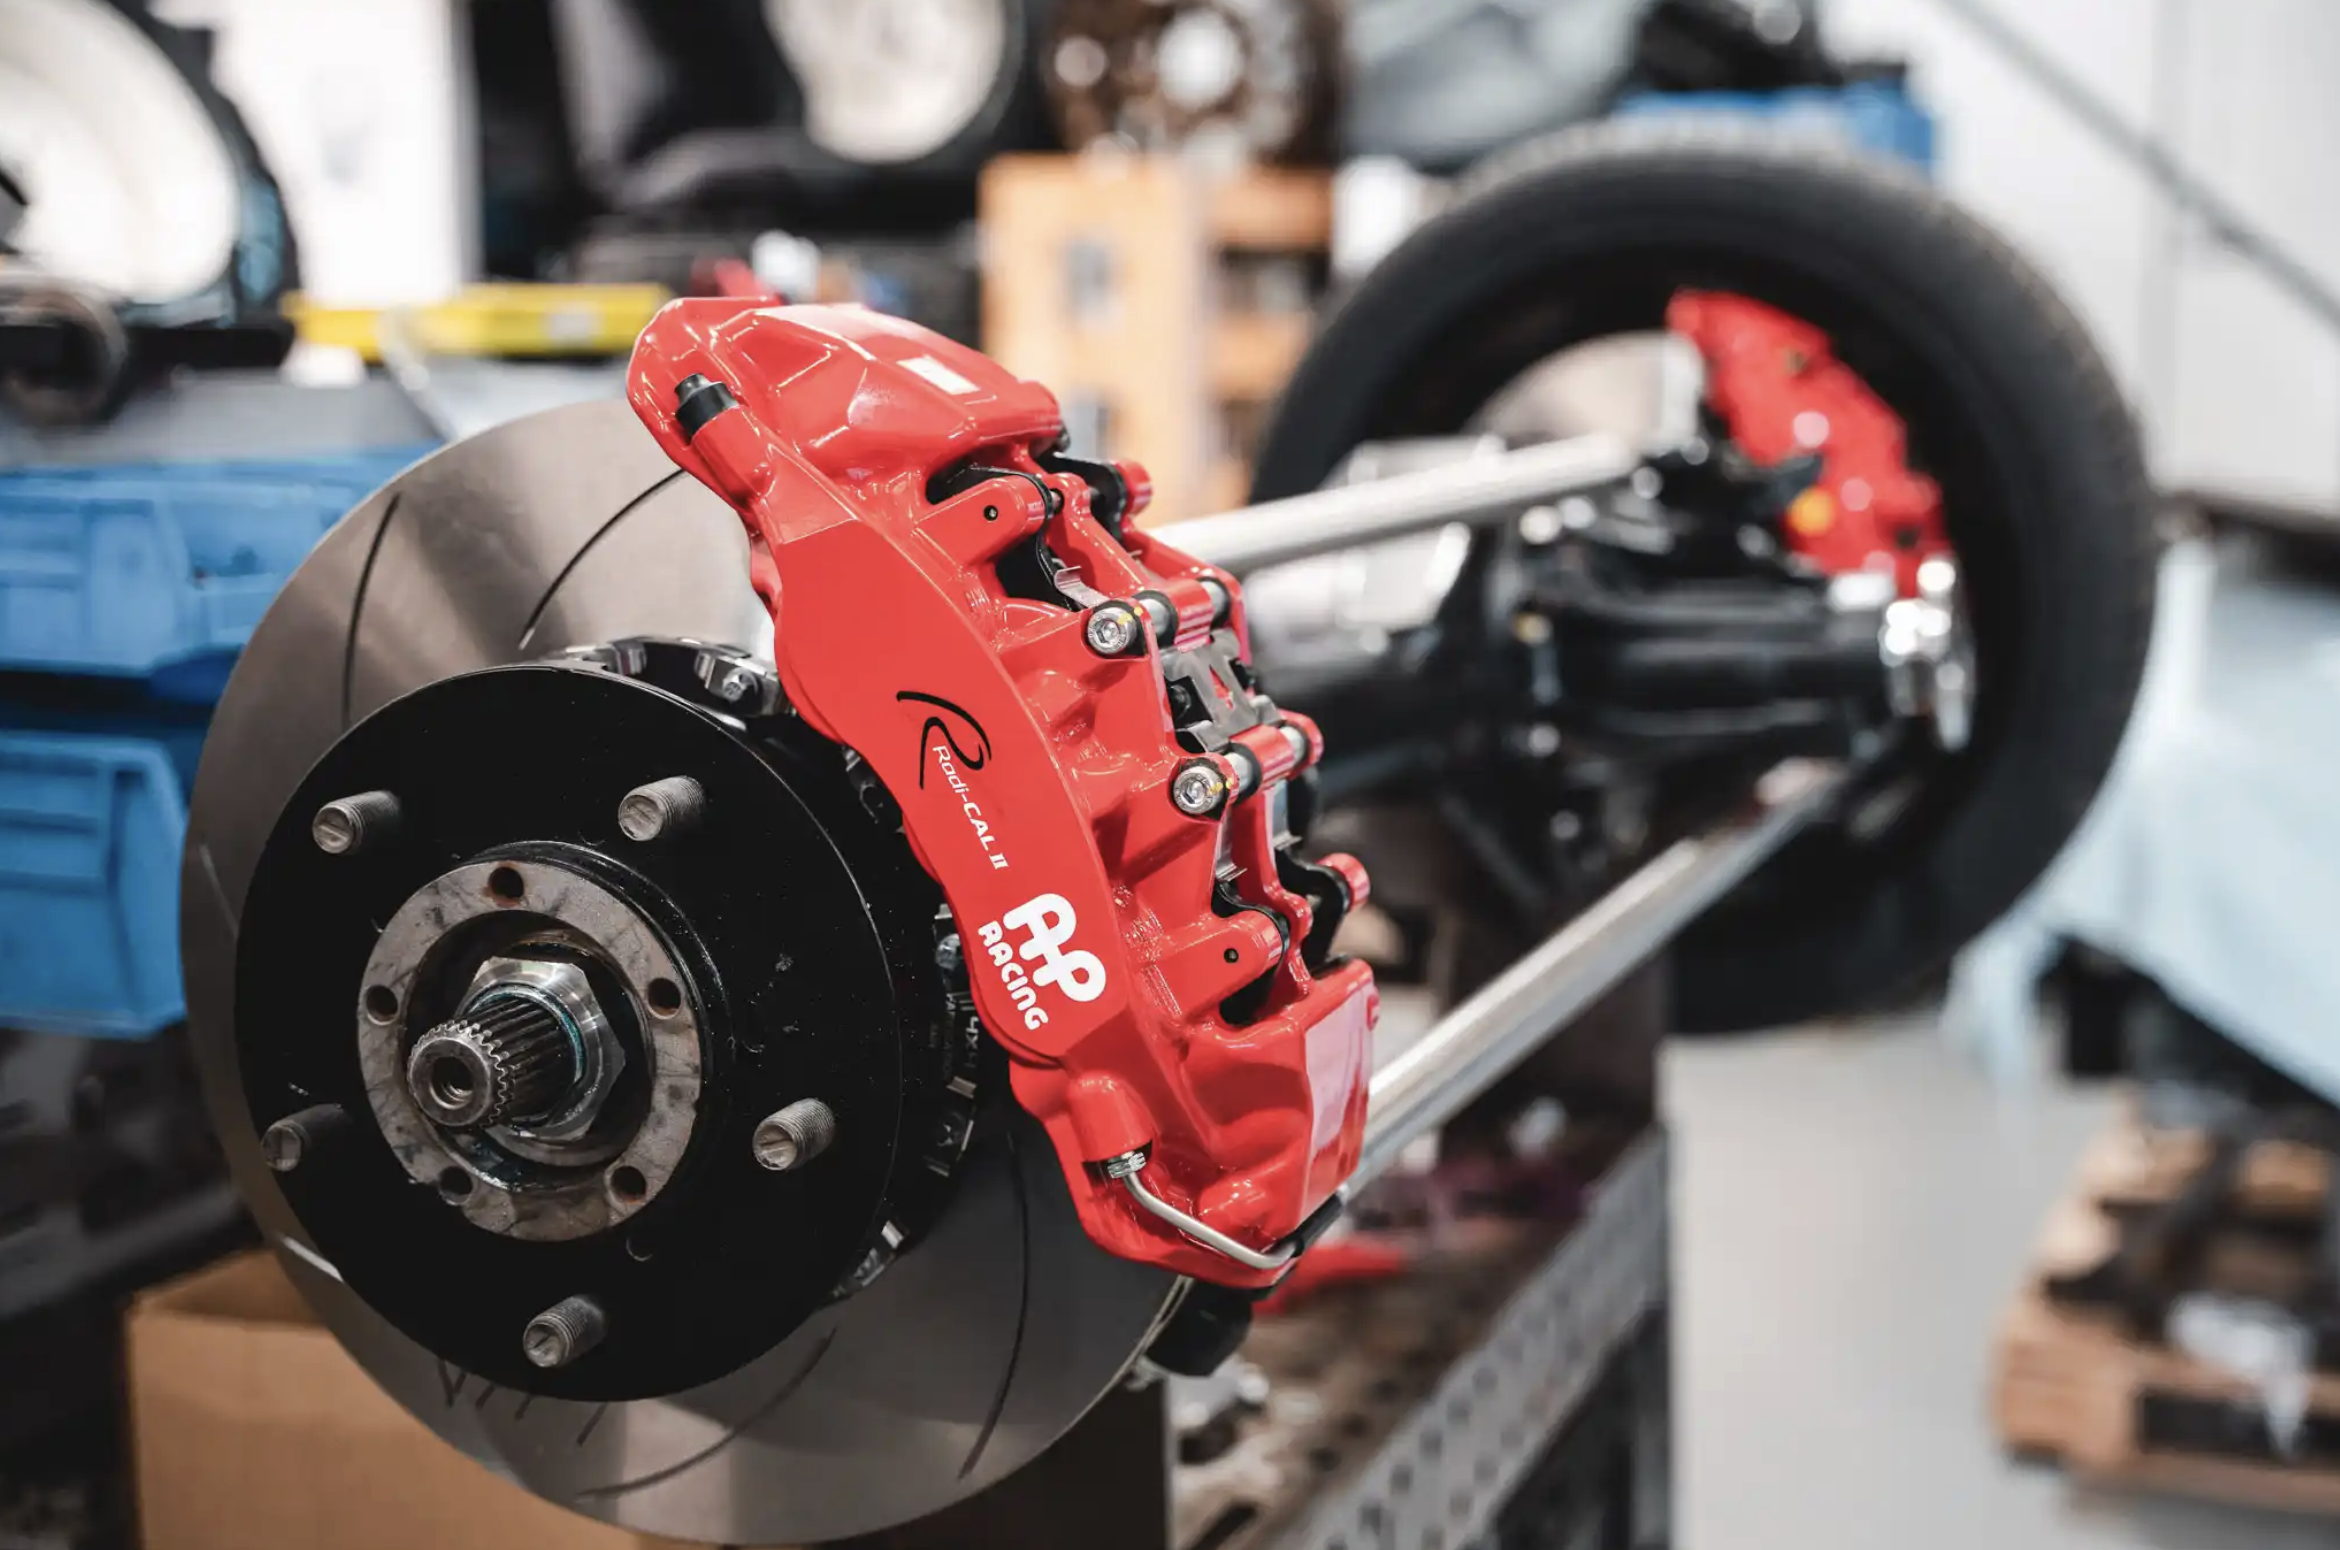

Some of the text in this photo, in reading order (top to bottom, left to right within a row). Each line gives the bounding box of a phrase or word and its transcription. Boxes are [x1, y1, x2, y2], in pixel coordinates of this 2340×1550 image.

[932, 745, 995, 851] Radi-CAL
[978, 920, 1049, 1031] RACING
[1003, 893, 1107, 1002] AP
